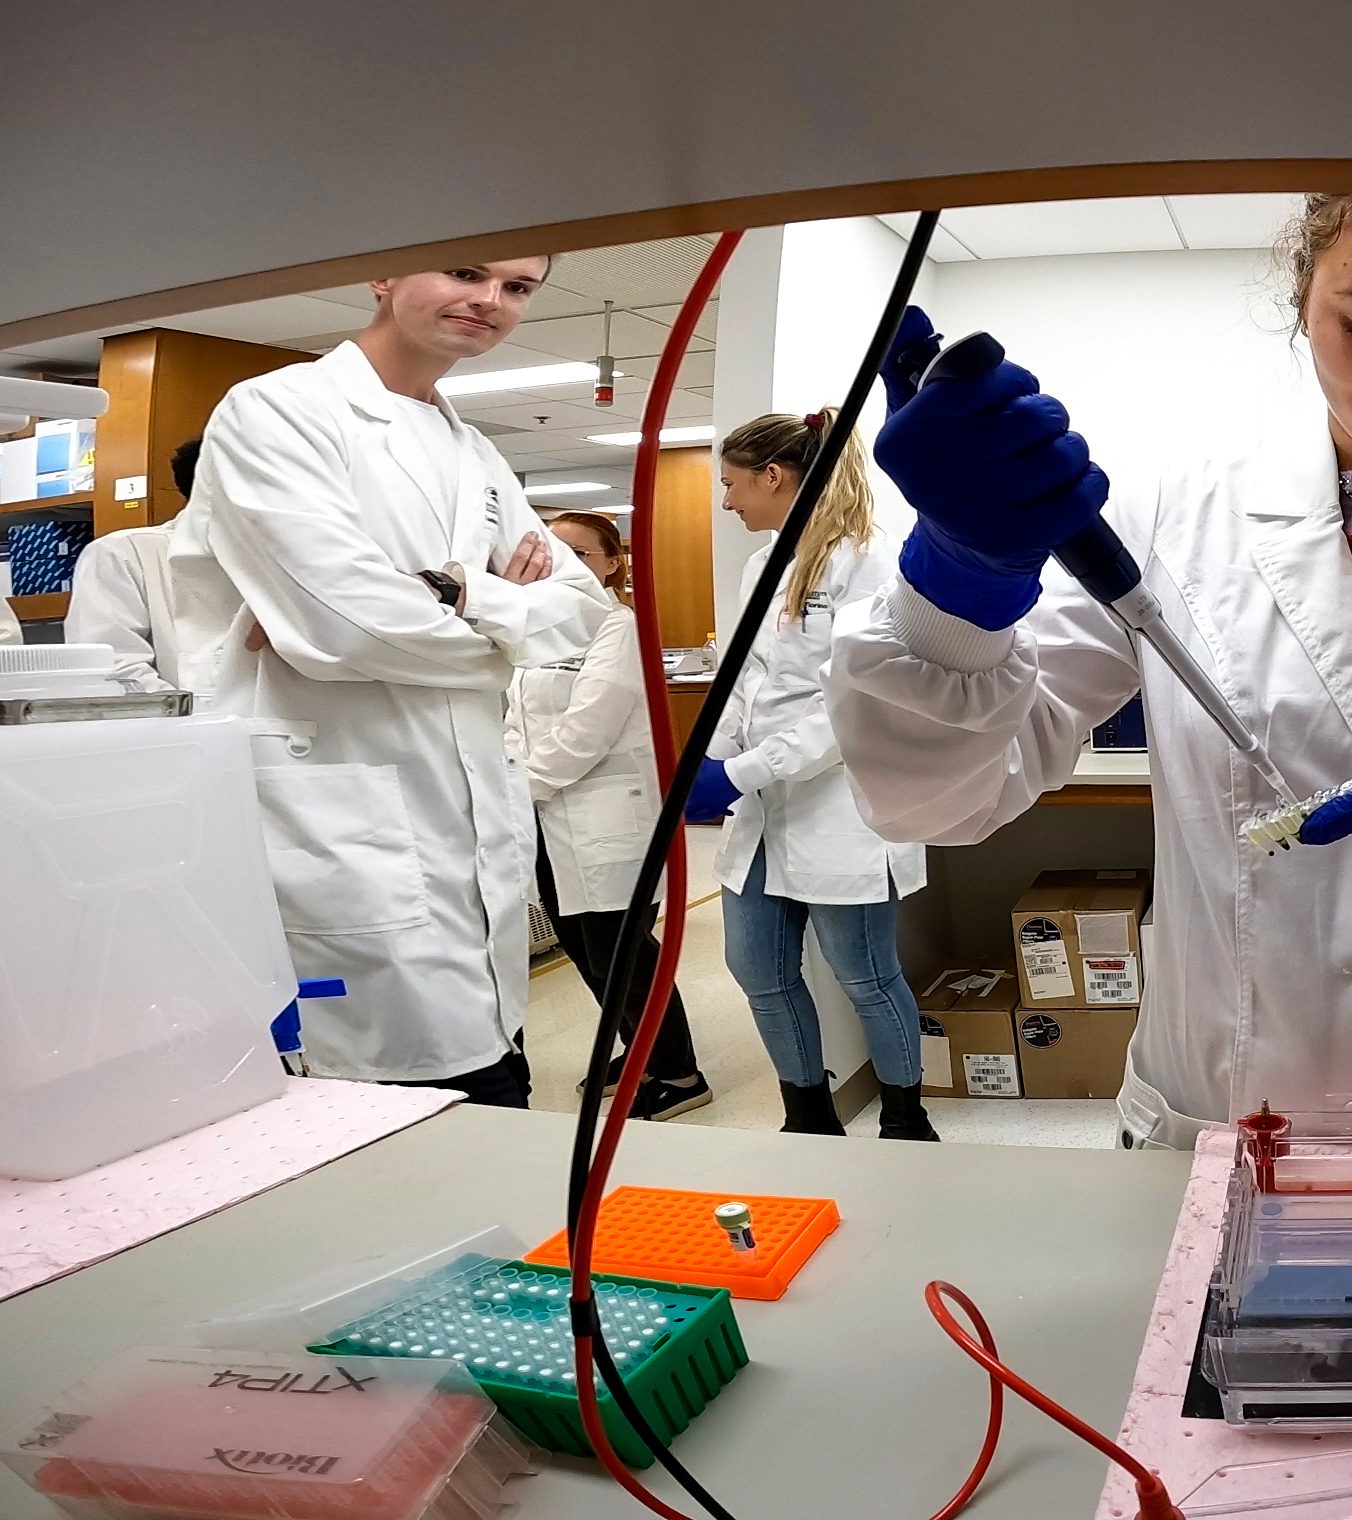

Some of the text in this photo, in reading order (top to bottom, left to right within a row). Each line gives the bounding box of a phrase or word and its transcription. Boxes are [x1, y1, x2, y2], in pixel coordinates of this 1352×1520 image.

[128, 483, 135, 494] 3
[207, 1366, 379, 1395] XTIP4
[203, 1447, 343, 1475] Biotix
